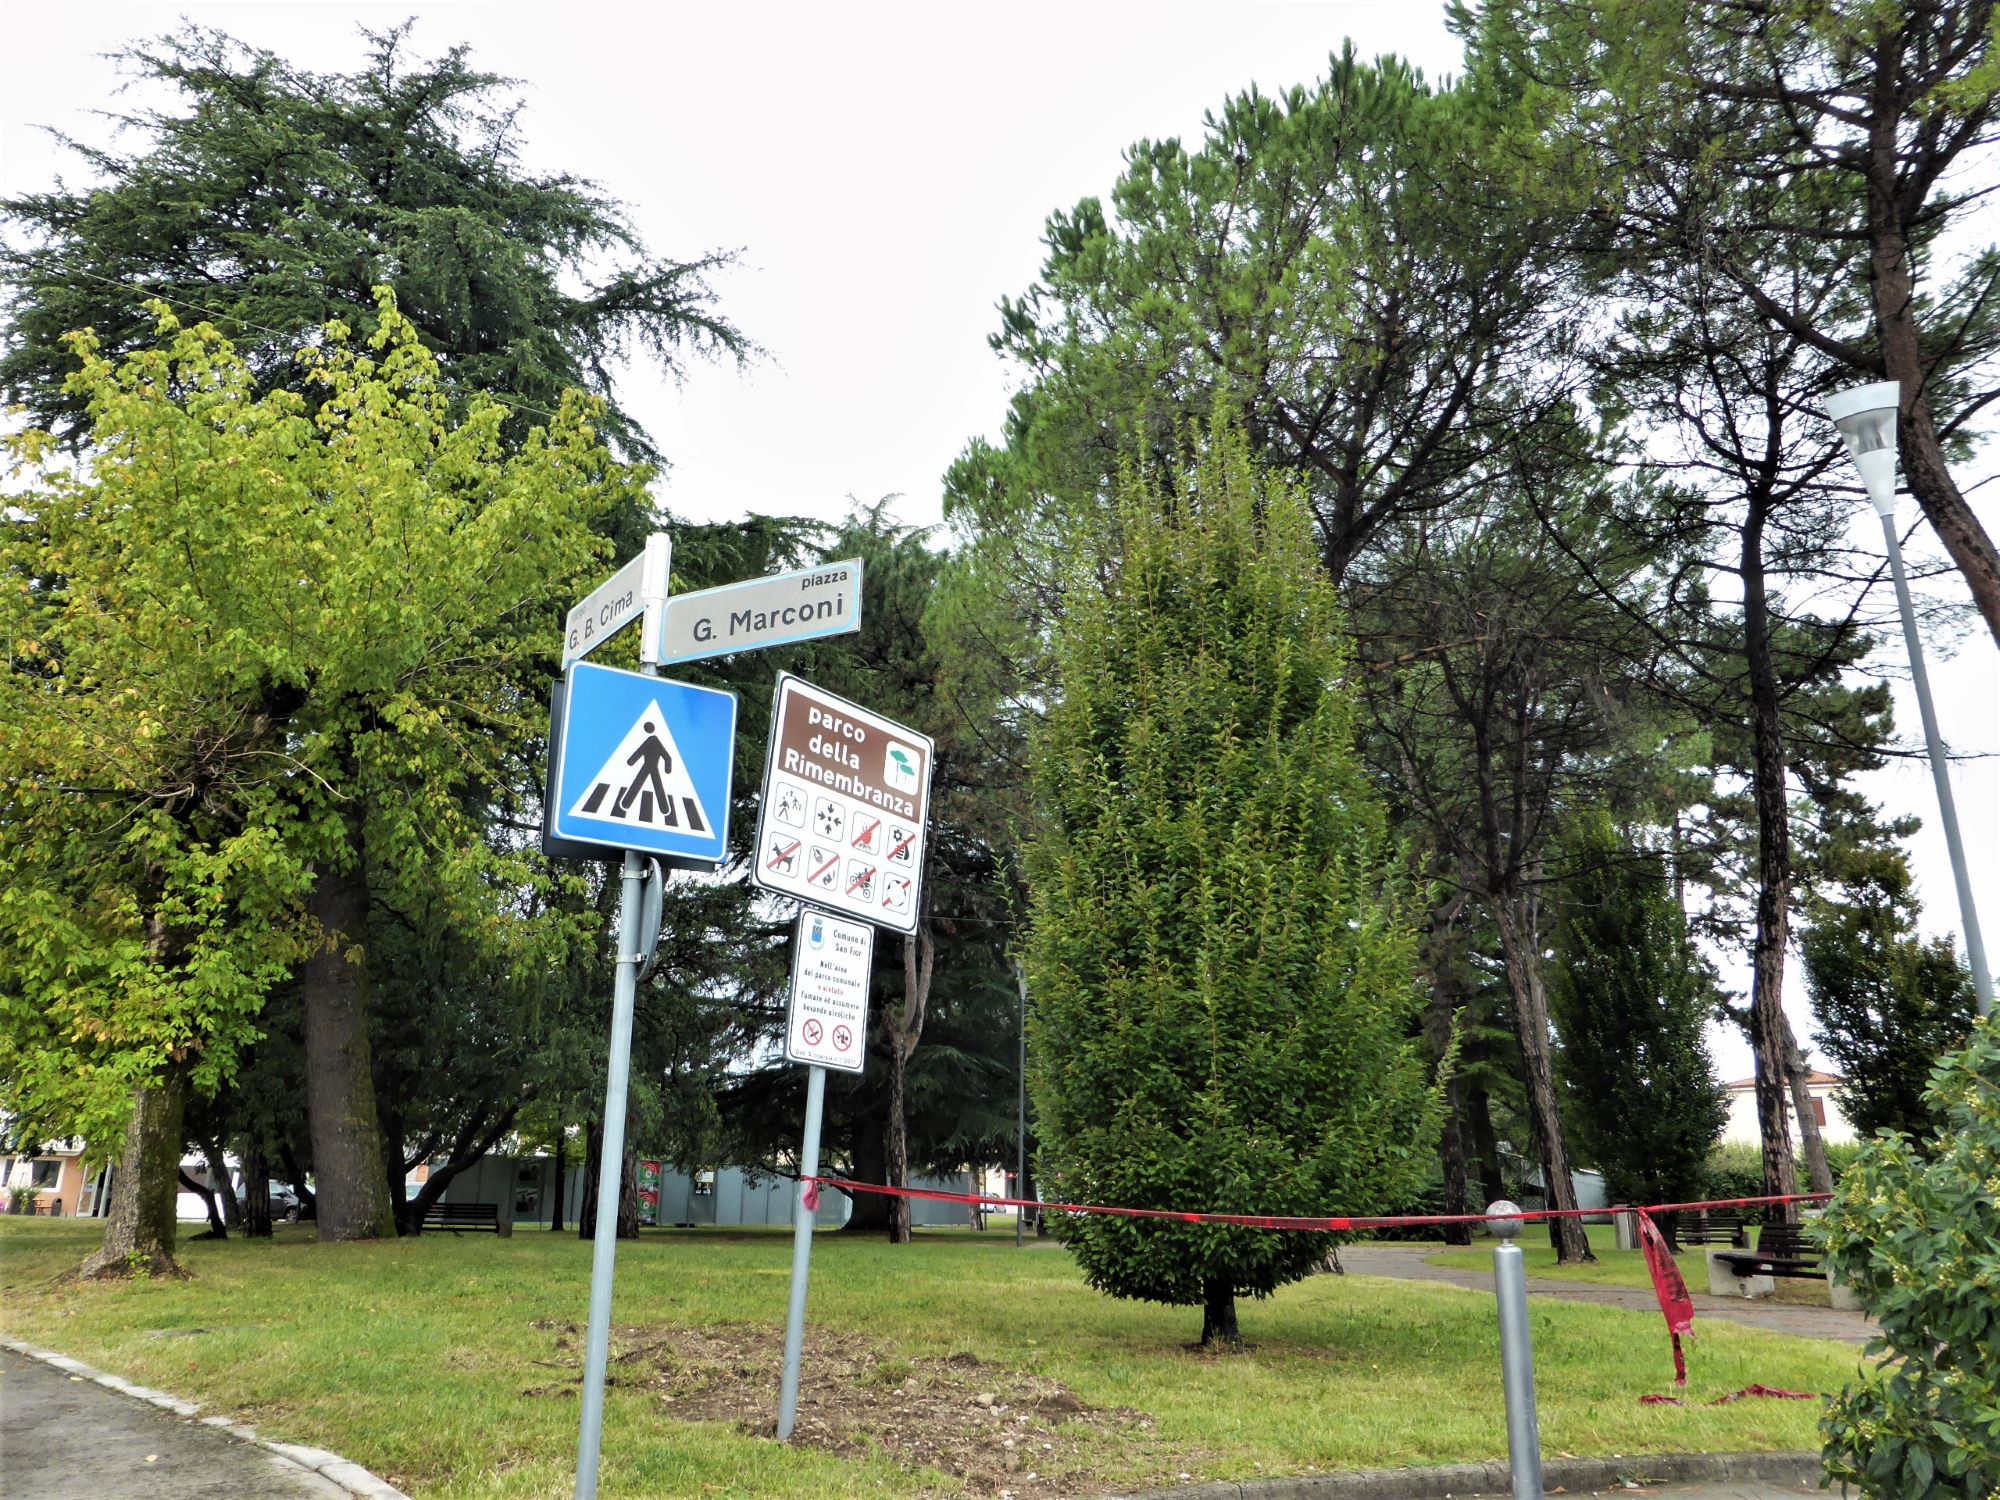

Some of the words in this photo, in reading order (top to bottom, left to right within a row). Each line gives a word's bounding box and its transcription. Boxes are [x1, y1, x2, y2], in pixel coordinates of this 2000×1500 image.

[801, 570, 848, 590] piazza
[569, 628, 580, 650] G.
[584, 617, 594, 640] B.
[600, 590, 633, 627] Cima
[693, 618, 717, 642] G.
[729, 593, 843, 635] Marconi
[808, 706, 866, 743] parco
[808, 734, 860, 770] della
[784, 748, 914, 818] Rimembranza
[833, 929, 859, 944] Comune
[860, 935, 866, 946] di
[835, 942, 848, 955] San
[849, 946, 863, 957] Fior
[814, 971, 831, 982] parco
[832, 975, 861, 988] comunale
[801, 990, 823, 1002] fumare
[832, 999, 859, 1010] assumere
[803, 1003, 827, 1015] bevande
